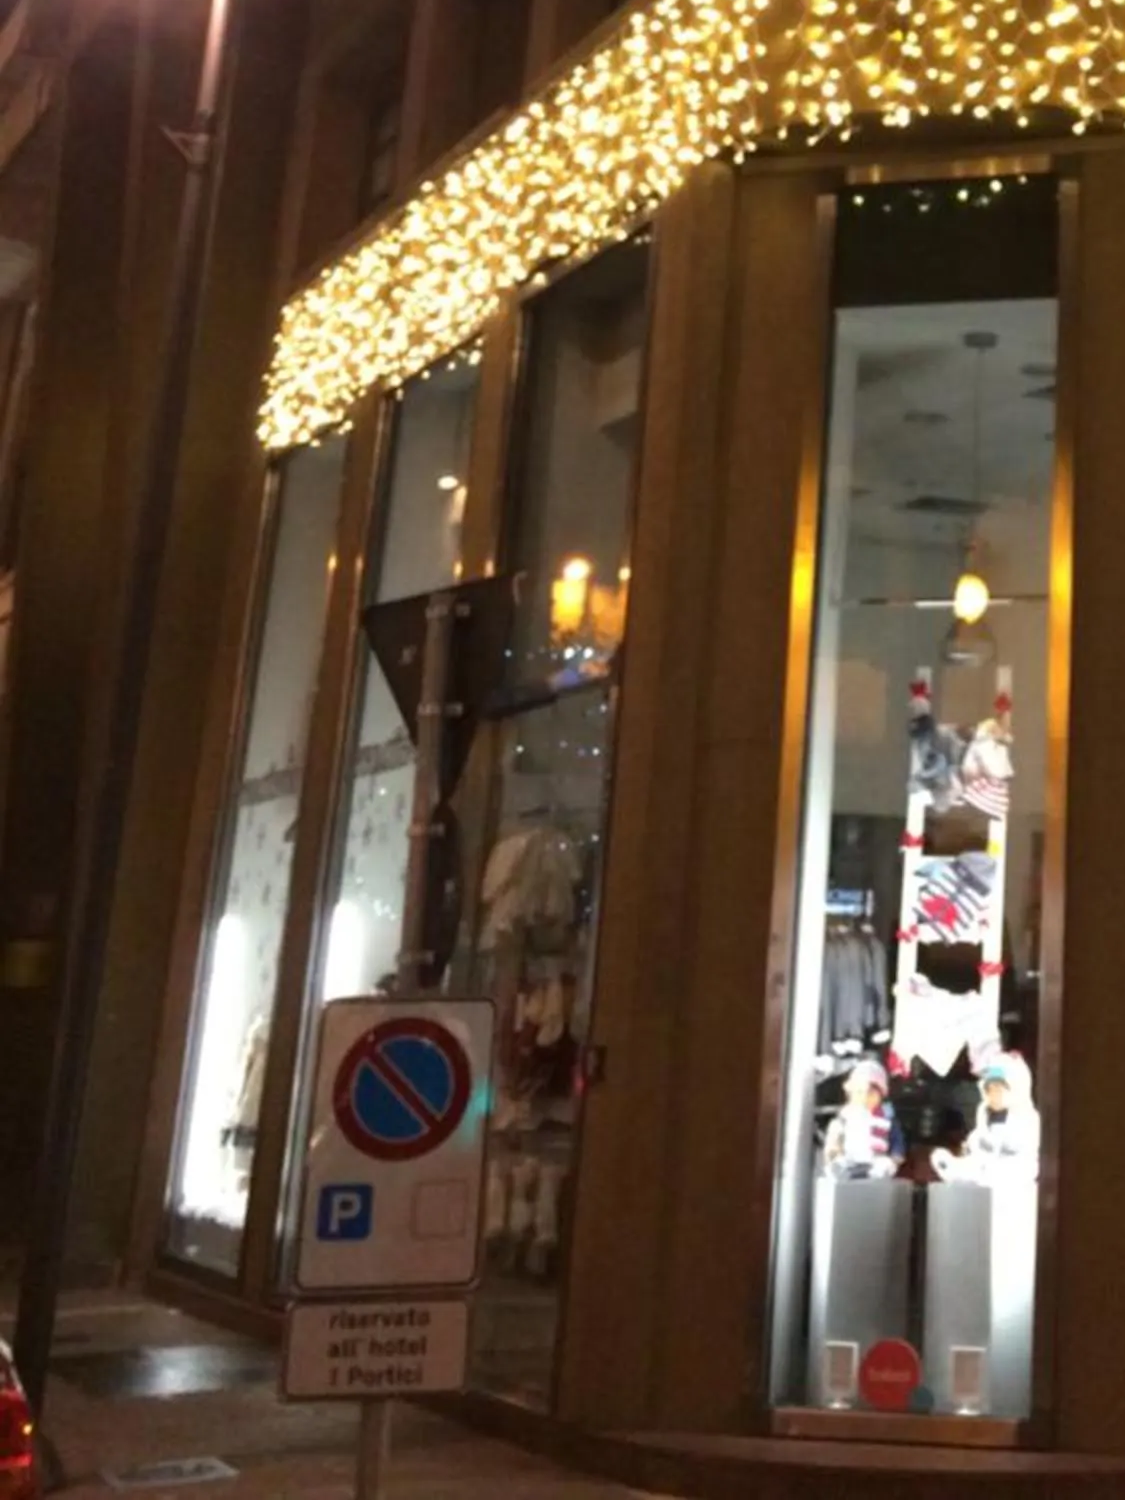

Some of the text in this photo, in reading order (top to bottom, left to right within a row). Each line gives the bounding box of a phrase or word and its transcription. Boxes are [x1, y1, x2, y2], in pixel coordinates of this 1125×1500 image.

[328, 1192, 362, 1233] P
[328, 1307, 431, 1330] riservato
[368, 1335, 428, 1357] hotel
[347, 1362, 423, 1387] Portici
